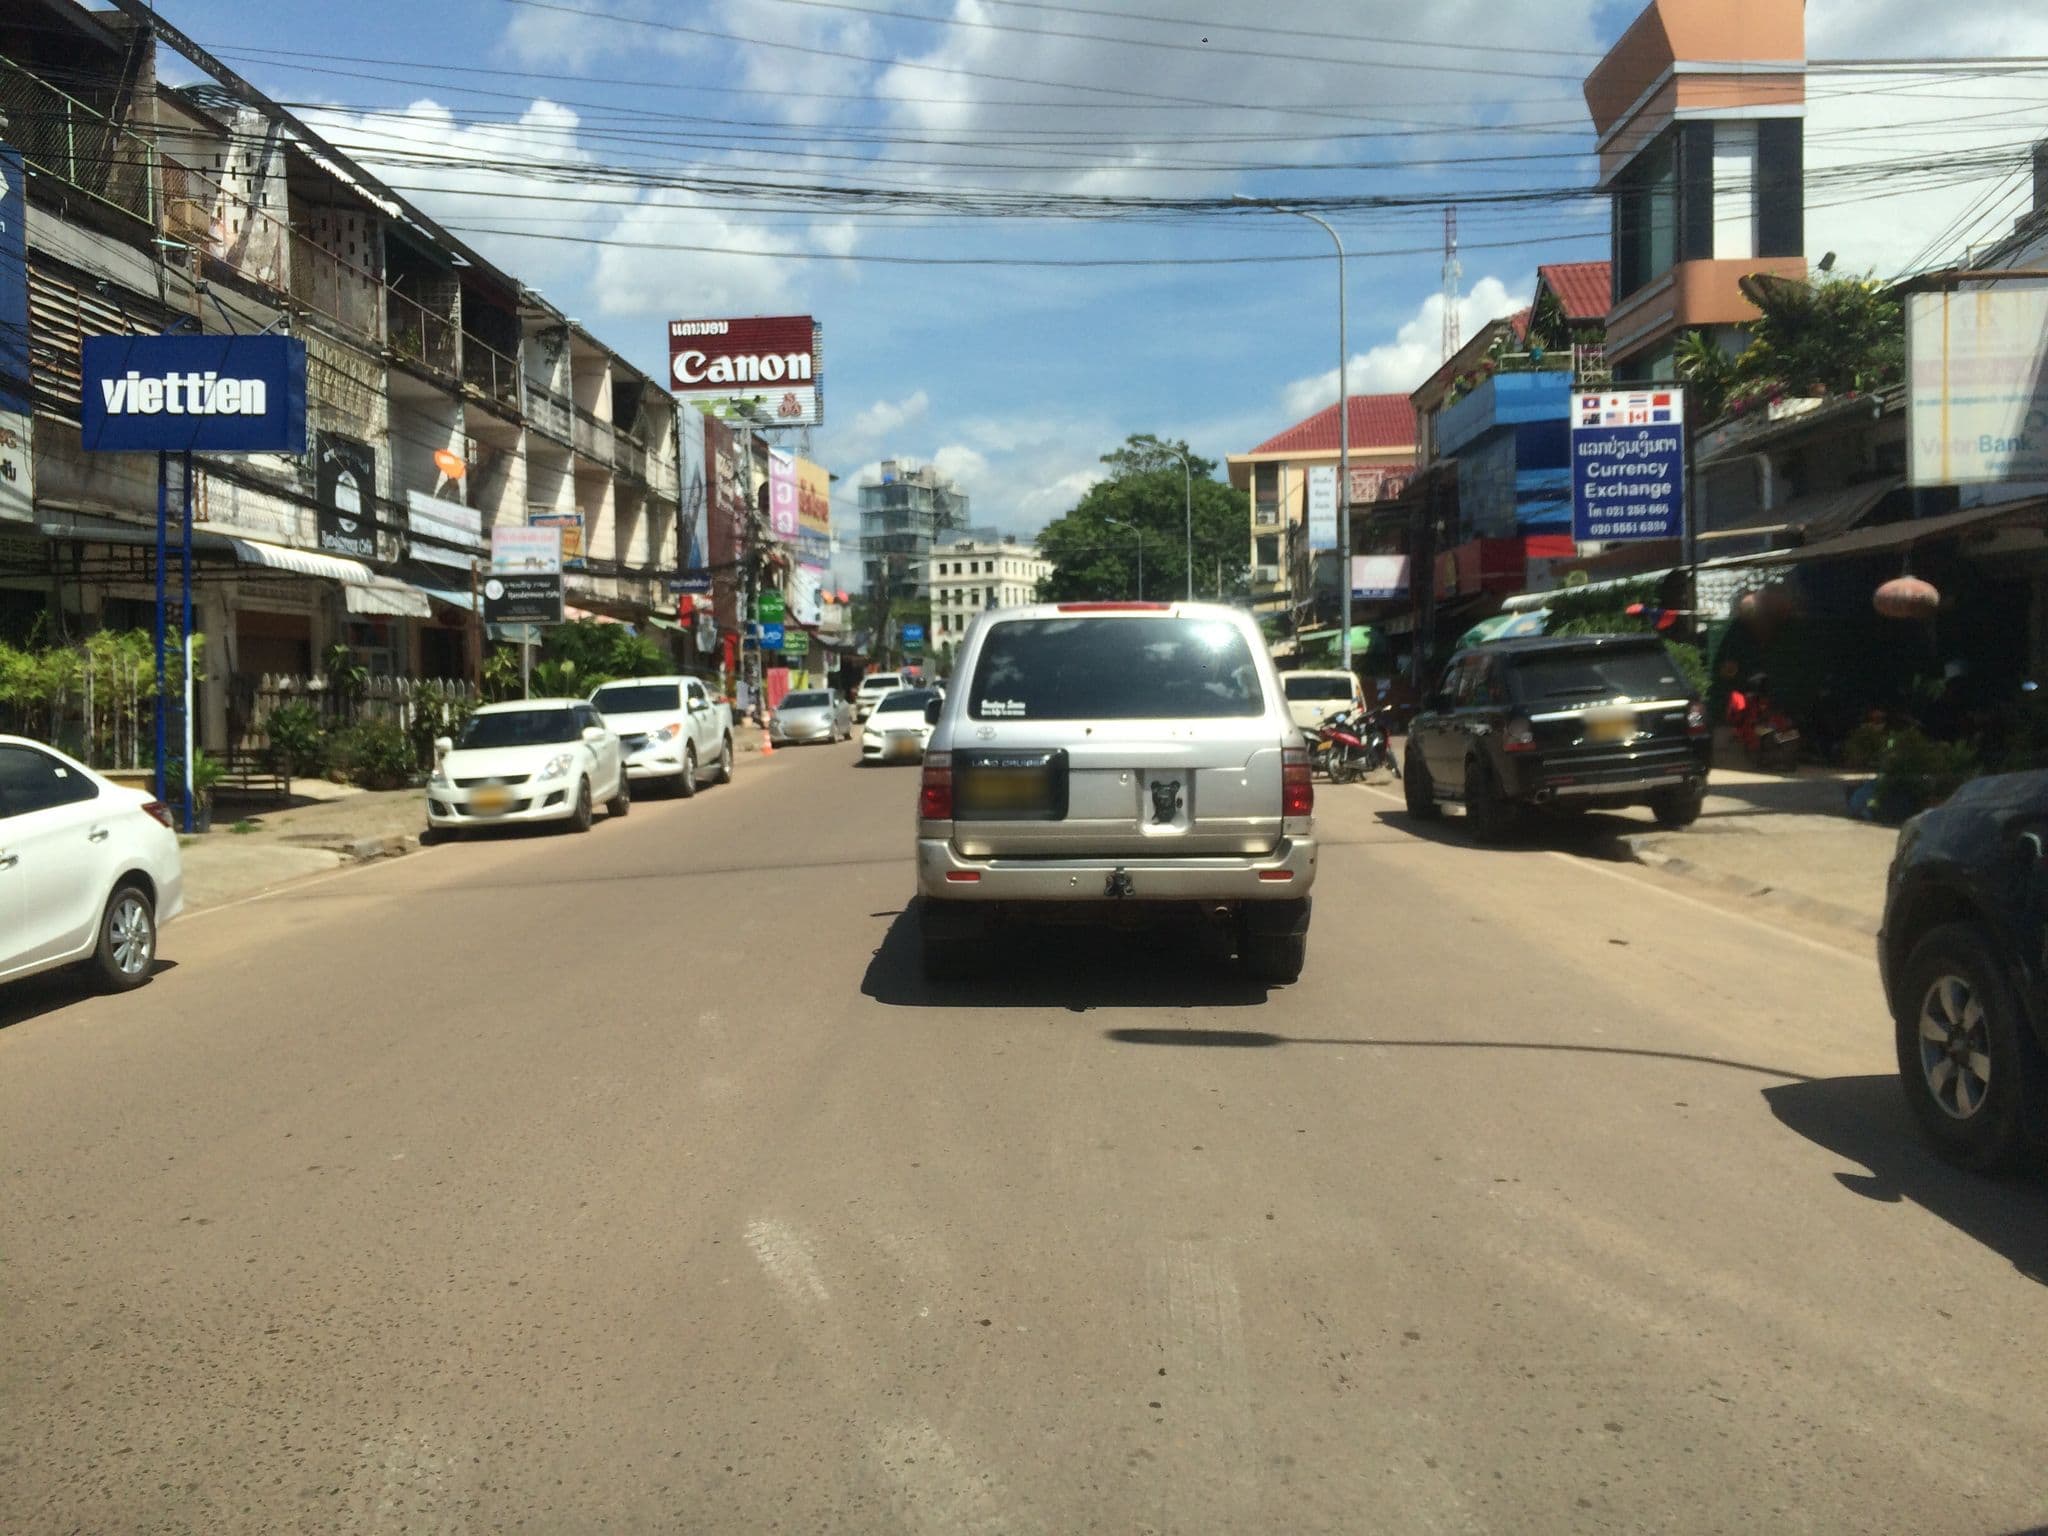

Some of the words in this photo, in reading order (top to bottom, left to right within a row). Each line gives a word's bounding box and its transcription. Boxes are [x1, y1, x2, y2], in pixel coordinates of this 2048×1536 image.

[673, 350, 812, 384] Canon
[101, 370, 266, 415] viettien
[1587, 461, 1669, 478] Currency
[1584, 481, 1672, 499] Exchange
